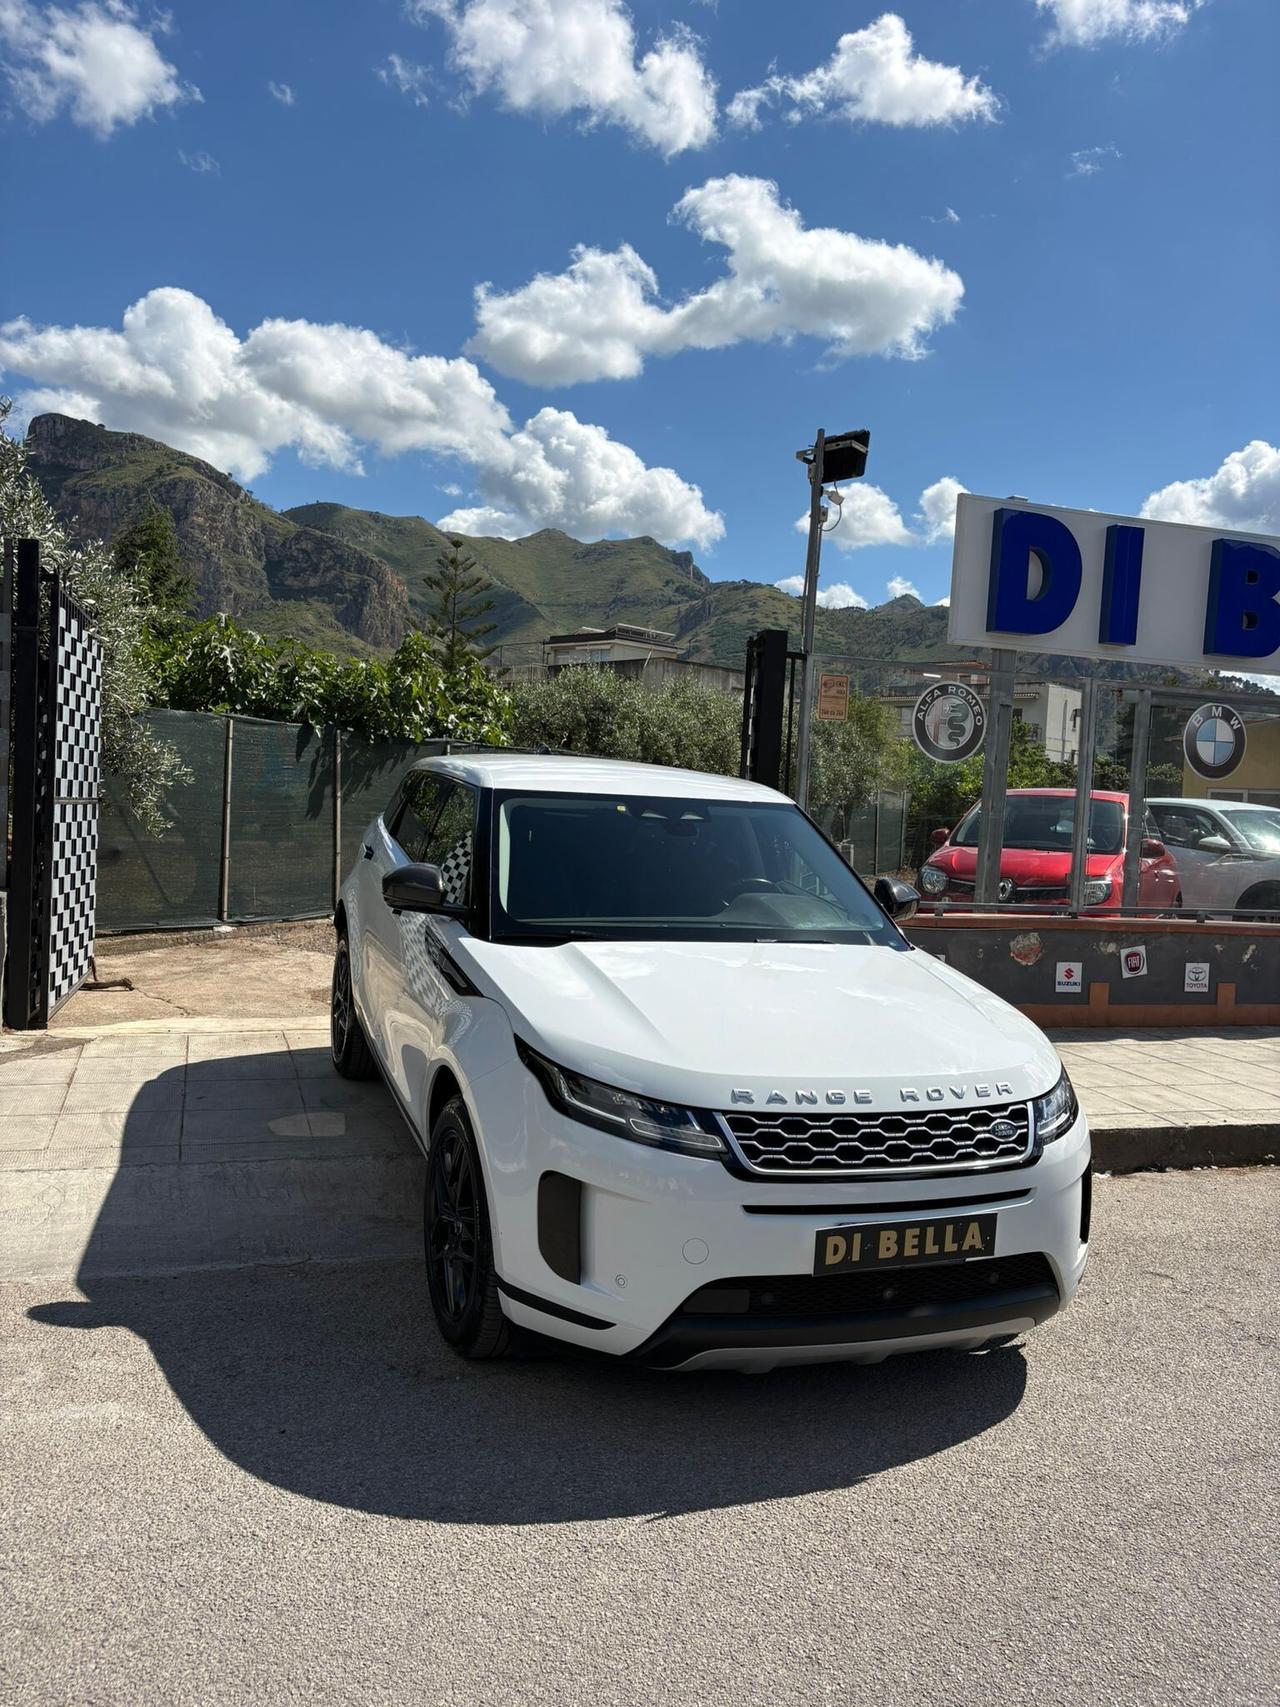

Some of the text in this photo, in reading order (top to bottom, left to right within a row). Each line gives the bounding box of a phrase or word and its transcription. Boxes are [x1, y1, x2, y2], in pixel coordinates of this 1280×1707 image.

[985, 508, 1280, 658] DI B
[917, 686, 983, 726] ALFA ROMEO
[1192, 706, 1241, 730] BMW
[1127, 956, 1140, 968] FIAT
[731, 1081, 1014, 1105] RANGE ROVER
[825, 1222, 983, 1265] DI BELLA
